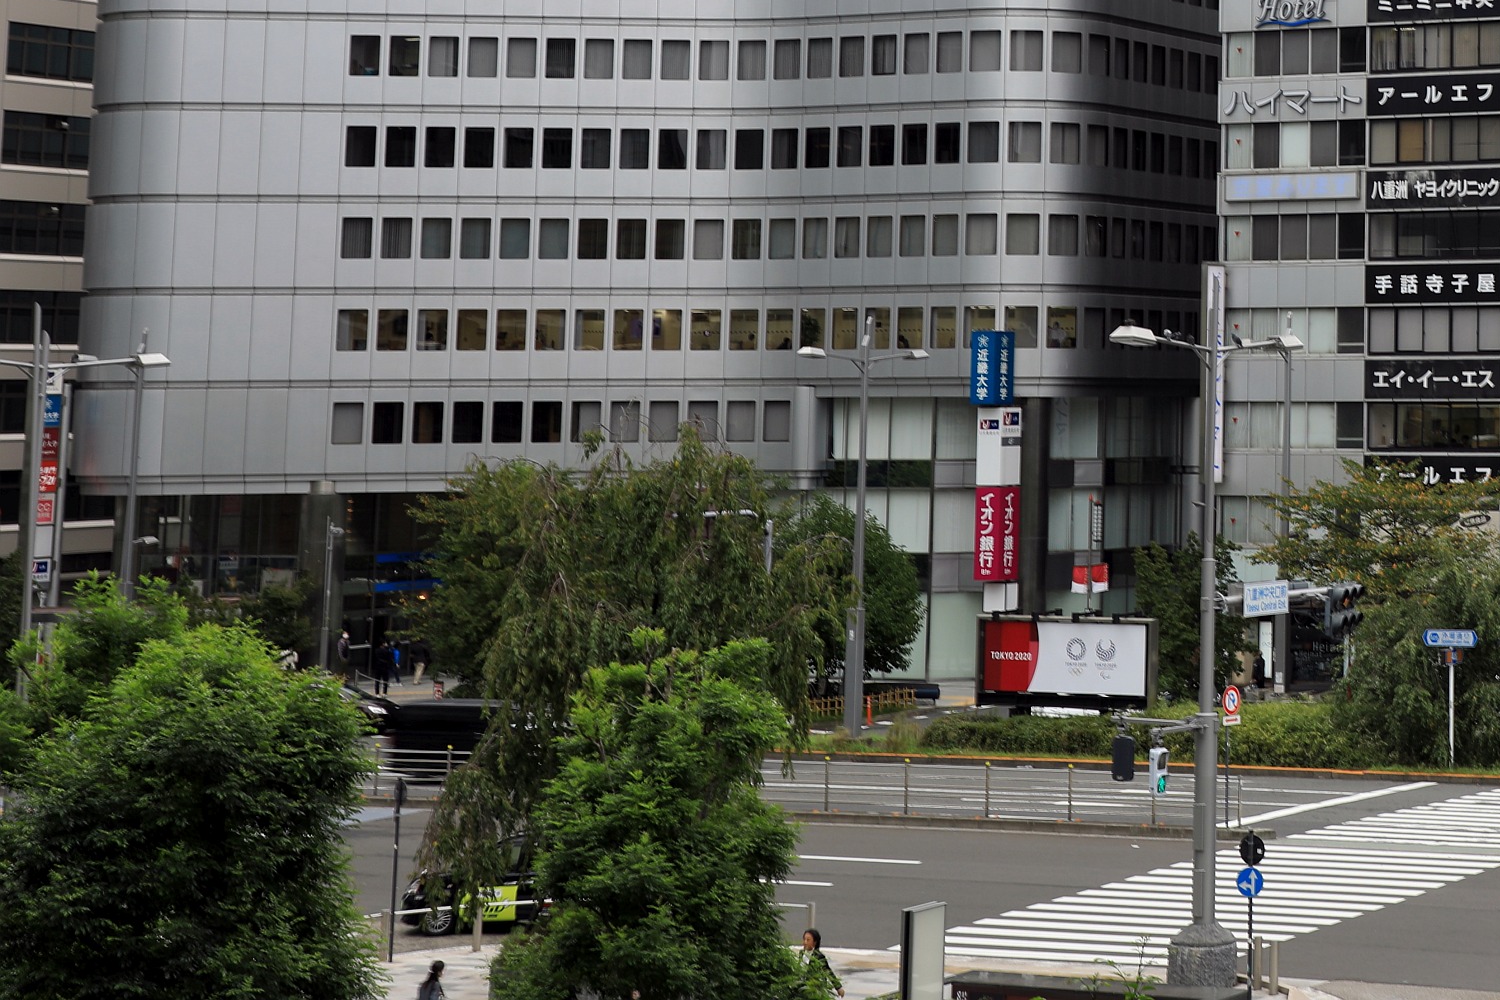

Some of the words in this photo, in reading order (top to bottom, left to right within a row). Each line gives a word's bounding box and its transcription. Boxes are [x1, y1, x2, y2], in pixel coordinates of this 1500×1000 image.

[1224, 85, 1362, 116] ハイマート
[1378, 83, 1494, 105] アールエフ
[1371, 180, 1408, 200] 八重洲
[1414, 177, 1500, 199] ヤヨイクリニック
[1374, 274, 1496, 294] 手話寺子屋
[976, 348, 989, 401] 近畿大学
[1373, 369, 1495, 389] エイ・イー・エス
[979, 492, 995, 569] イオン銀行
[1003, 492, 1014, 567] イオン銀行
[990, 651, 1013, 661] TOKYO
[1014, 651, 1032, 661] 2020
